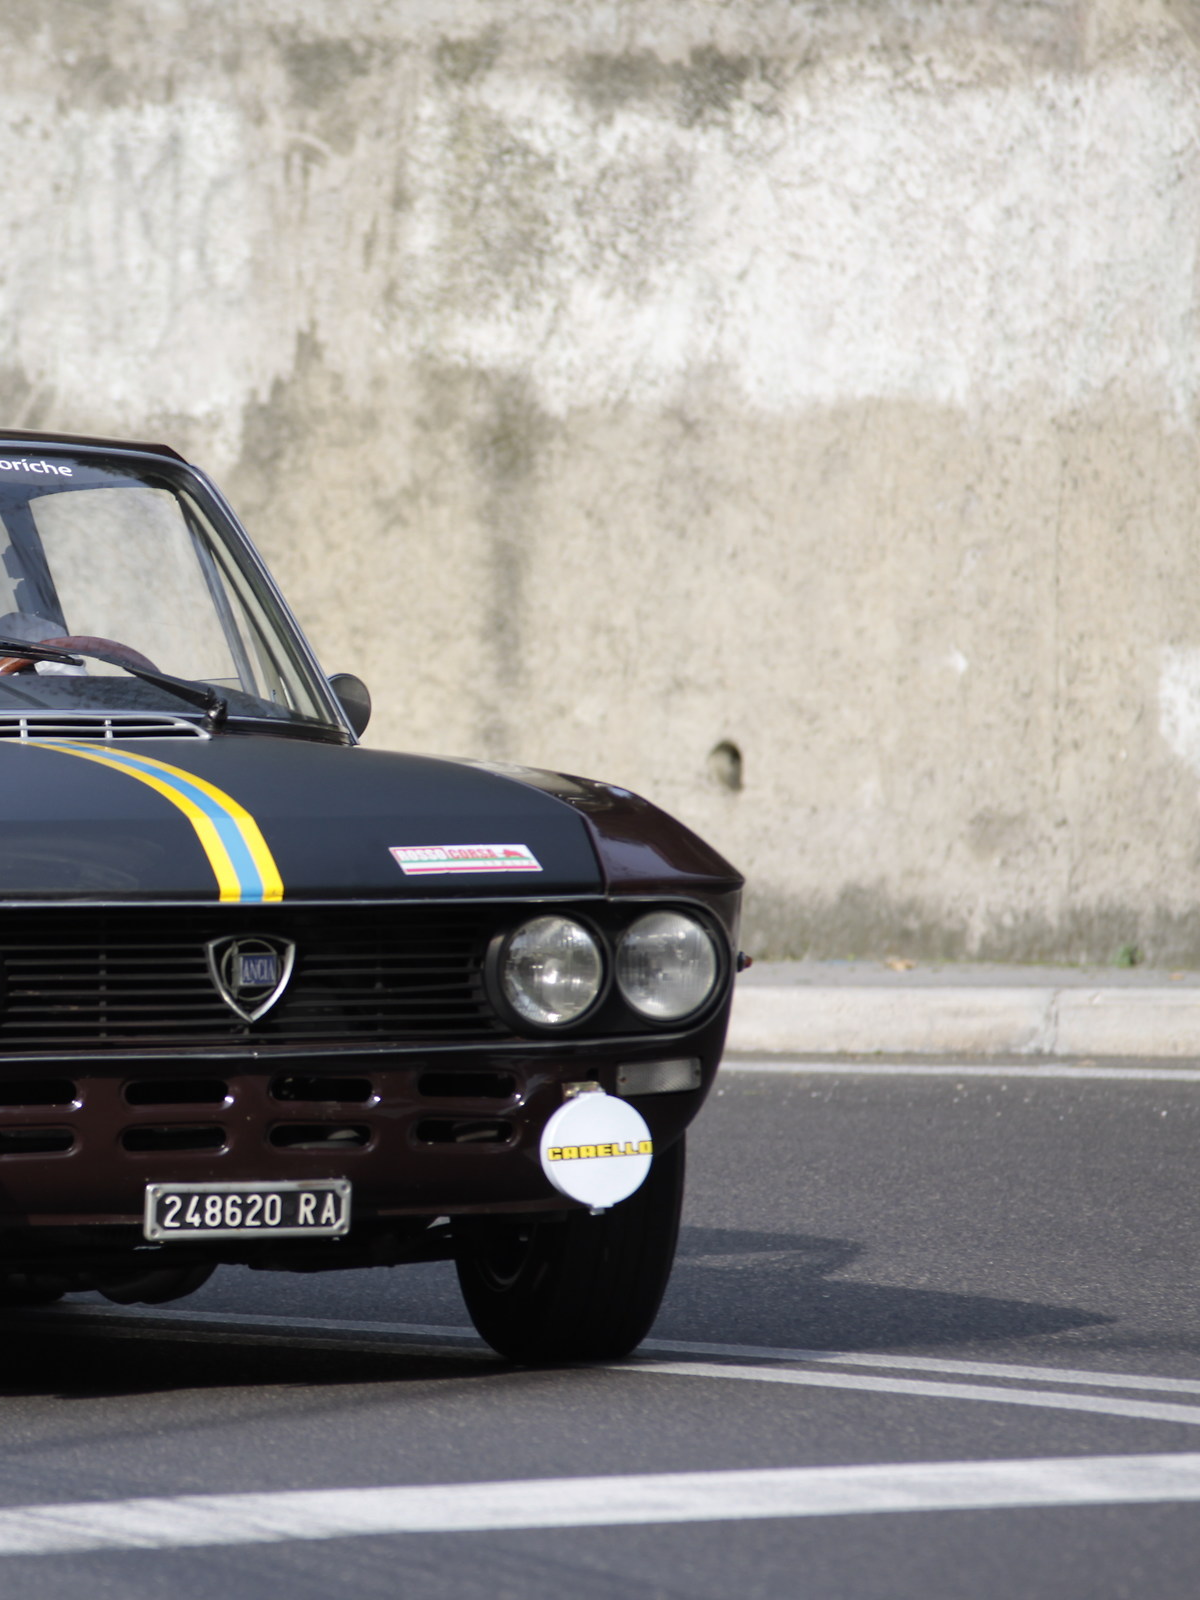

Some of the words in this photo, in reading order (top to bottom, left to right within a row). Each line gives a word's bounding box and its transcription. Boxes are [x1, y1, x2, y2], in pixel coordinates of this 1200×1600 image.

[448, 848, 498, 860] CORSA
[239, 956, 276, 985] LANCIA
[548, 1140, 654, 1161] CARELLO
[163, 1194, 282, 1228] 248620
[298, 1192, 337, 1226] RA
